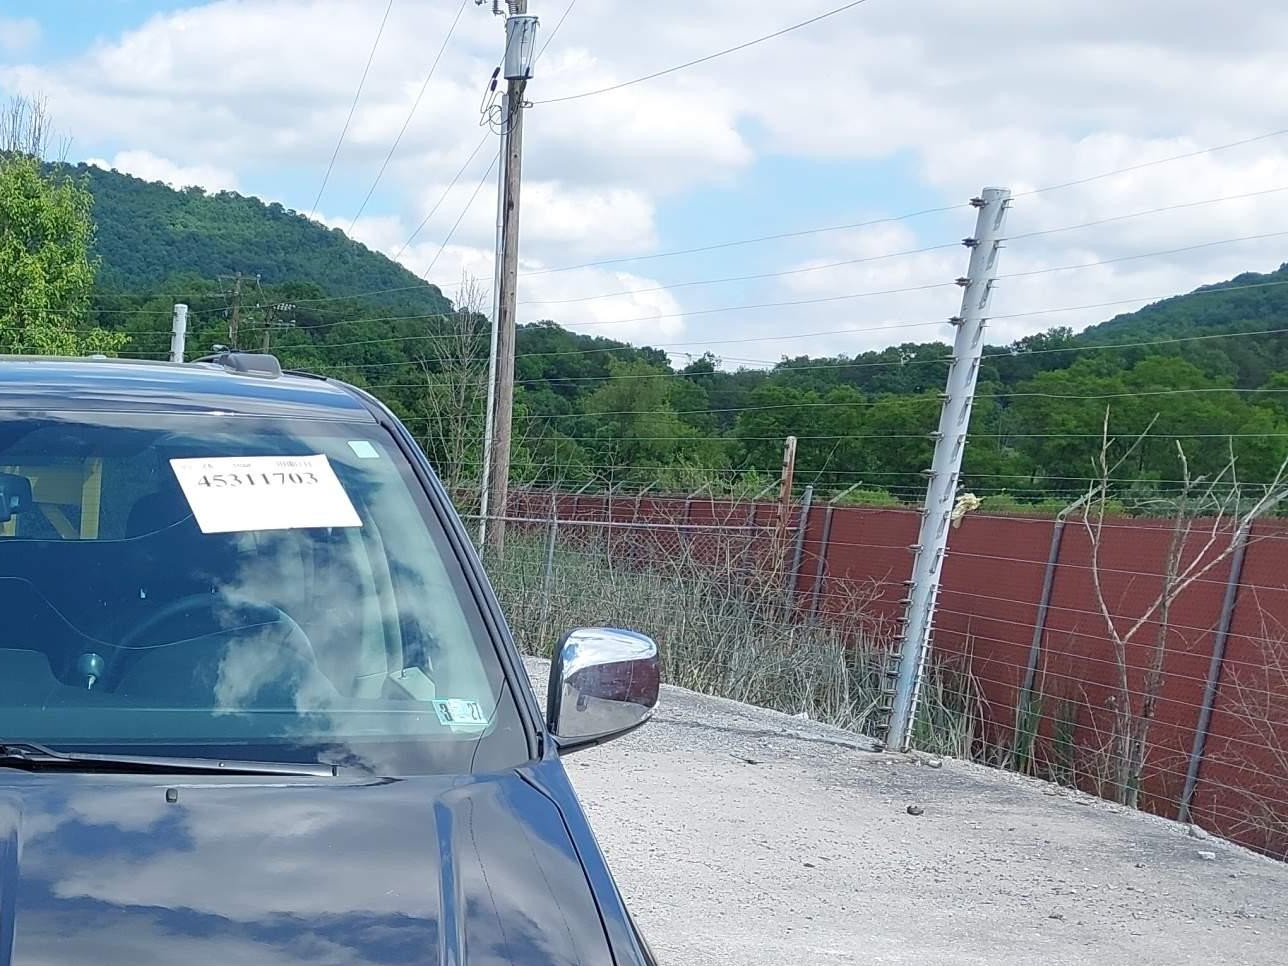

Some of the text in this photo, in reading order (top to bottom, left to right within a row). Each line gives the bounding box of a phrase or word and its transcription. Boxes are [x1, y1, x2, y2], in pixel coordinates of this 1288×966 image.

[198, 472, 319, 488] 45311703
[439, 702, 482, 721] 3 27
